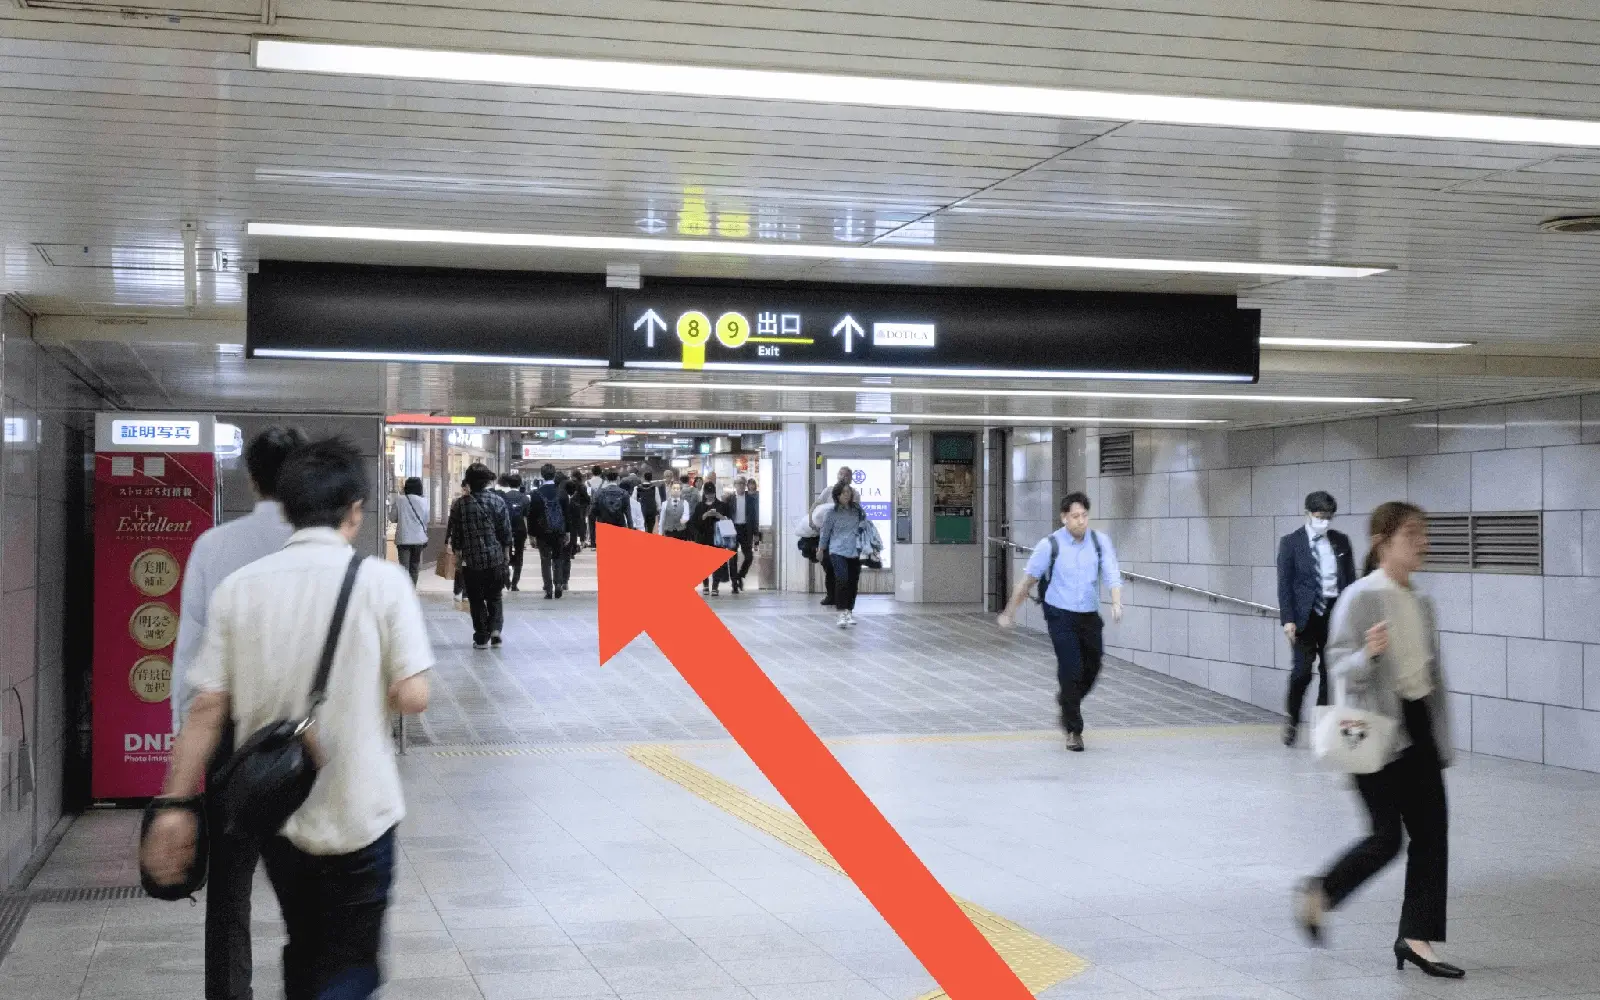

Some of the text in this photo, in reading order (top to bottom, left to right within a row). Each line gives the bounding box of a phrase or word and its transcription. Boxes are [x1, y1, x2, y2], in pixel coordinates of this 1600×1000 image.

[688, 311, 801, 339] 8 9 出口
[886, 330, 928, 340] DOTICA
[758, 346, 780, 356] Exit
[121, 425, 191, 439] 証明写真
[116, 516, 192, 532] Excellent
[144, 560, 170, 575] 美肌
[144, 576, 165, 587] 補正
[139, 615, 171, 628] 明るさ
[144, 629, 166, 640] 調整
[137, 668, 171, 681] 背景色
[144, 682, 165, 693] 選択
